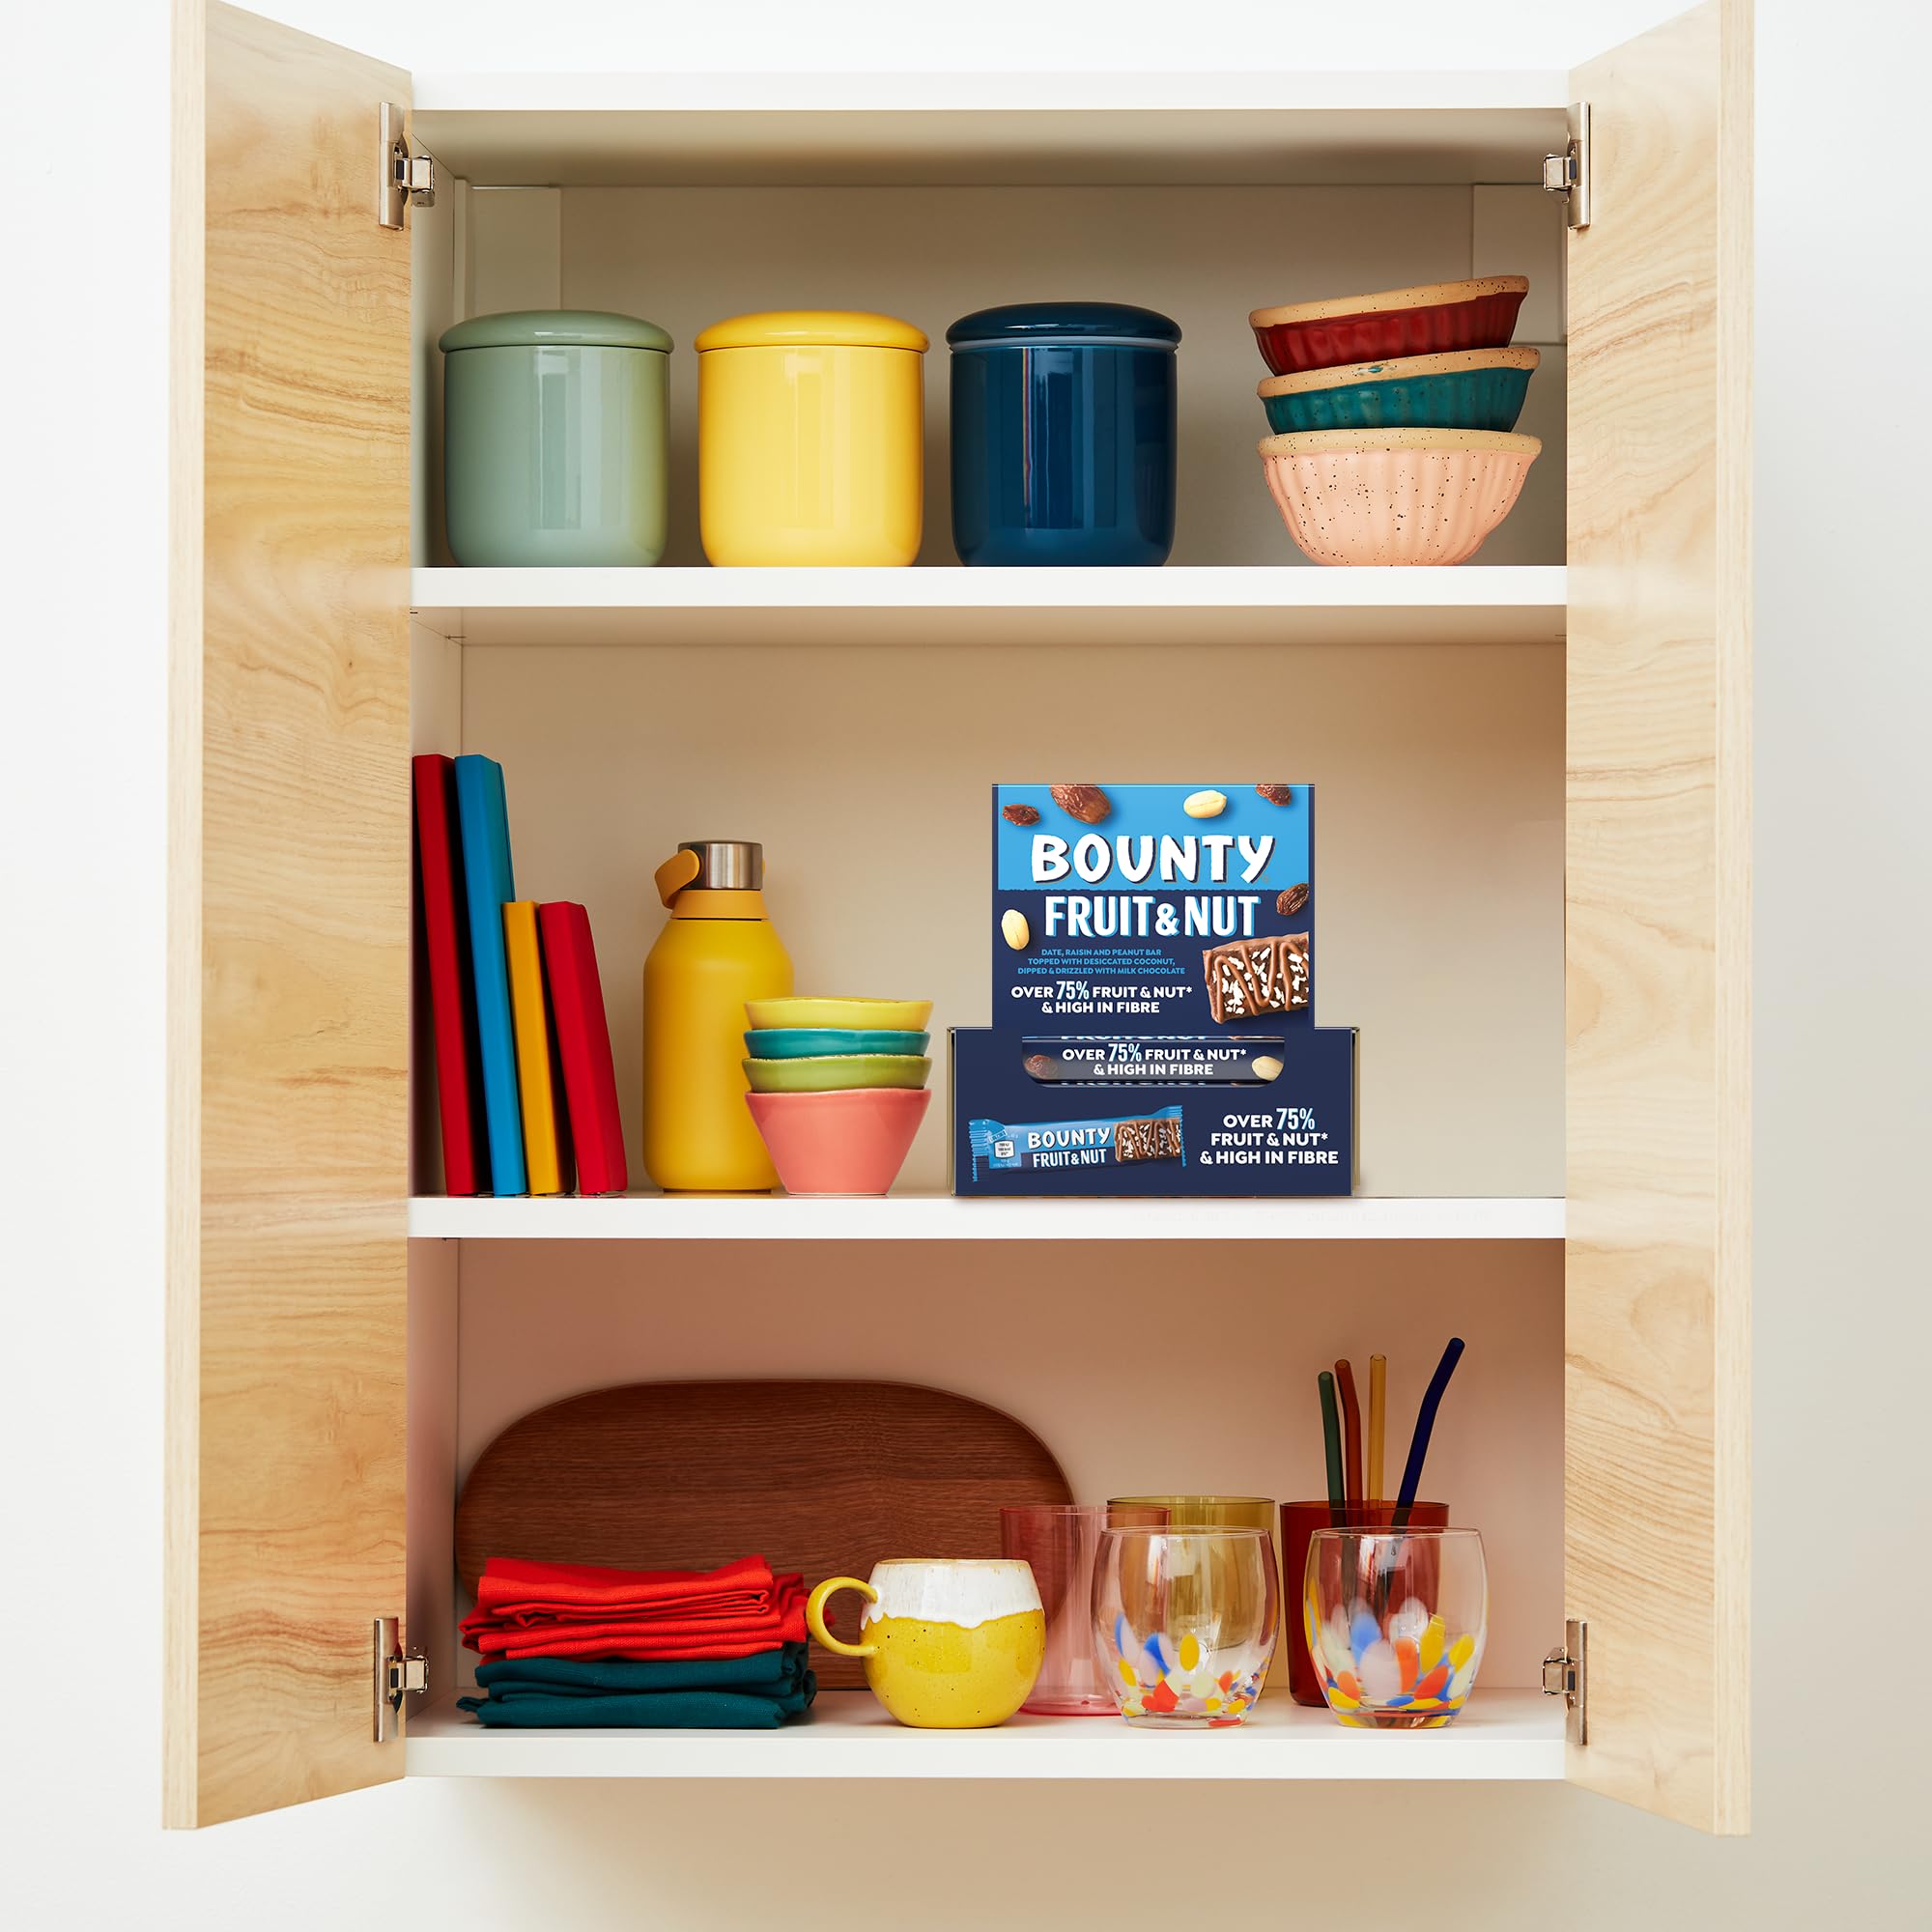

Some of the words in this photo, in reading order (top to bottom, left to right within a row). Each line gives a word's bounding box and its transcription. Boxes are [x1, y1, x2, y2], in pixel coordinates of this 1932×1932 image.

[1032, 834, 1275, 883] BOUNTY
[1011, 986, 1054, 998] OVER
[1056, 980, 1089, 999] 75%
[1093, 986, 1137, 998] FRUIT
[1140, 986, 1151, 998] &
[1041, 1002, 1053, 1013] &
[1056, 1002, 1094, 1012] HIGH
[1097, 1002, 1114, 1012] IN
[1117, 1002, 1159, 1012] FIBRE
[1062, 1049, 1105, 1061] OVER
[1108, 1043, 1142, 1062] 75%
[1145, 1049, 1190, 1060] FRUIT
[1193, 1049, 1205, 1061] &
[1094, 1065, 1105, 1075] &
[1108, 1065, 1146, 1075] HIGH
[1150, 1065, 1166, 1075] IN
[1170, 1065, 1213, 1075] FIBRE
[1223, 1115, 1272, 1127] OVER
[1276, 1108, 1315, 1130] 75%
[1028, 1127, 1111, 1149] BOUNTY
[1211, 1133, 1264, 1146] FRUIT
[1266, 1133, 1280, 1146] &
[1200, 1151, 1213, 1164] &
[1216, 1151, 1260, 1164] HIGH
[1265, 1151, 1283, 1164] IN
[1288, 1151, 1338, 1164] FIBRE
